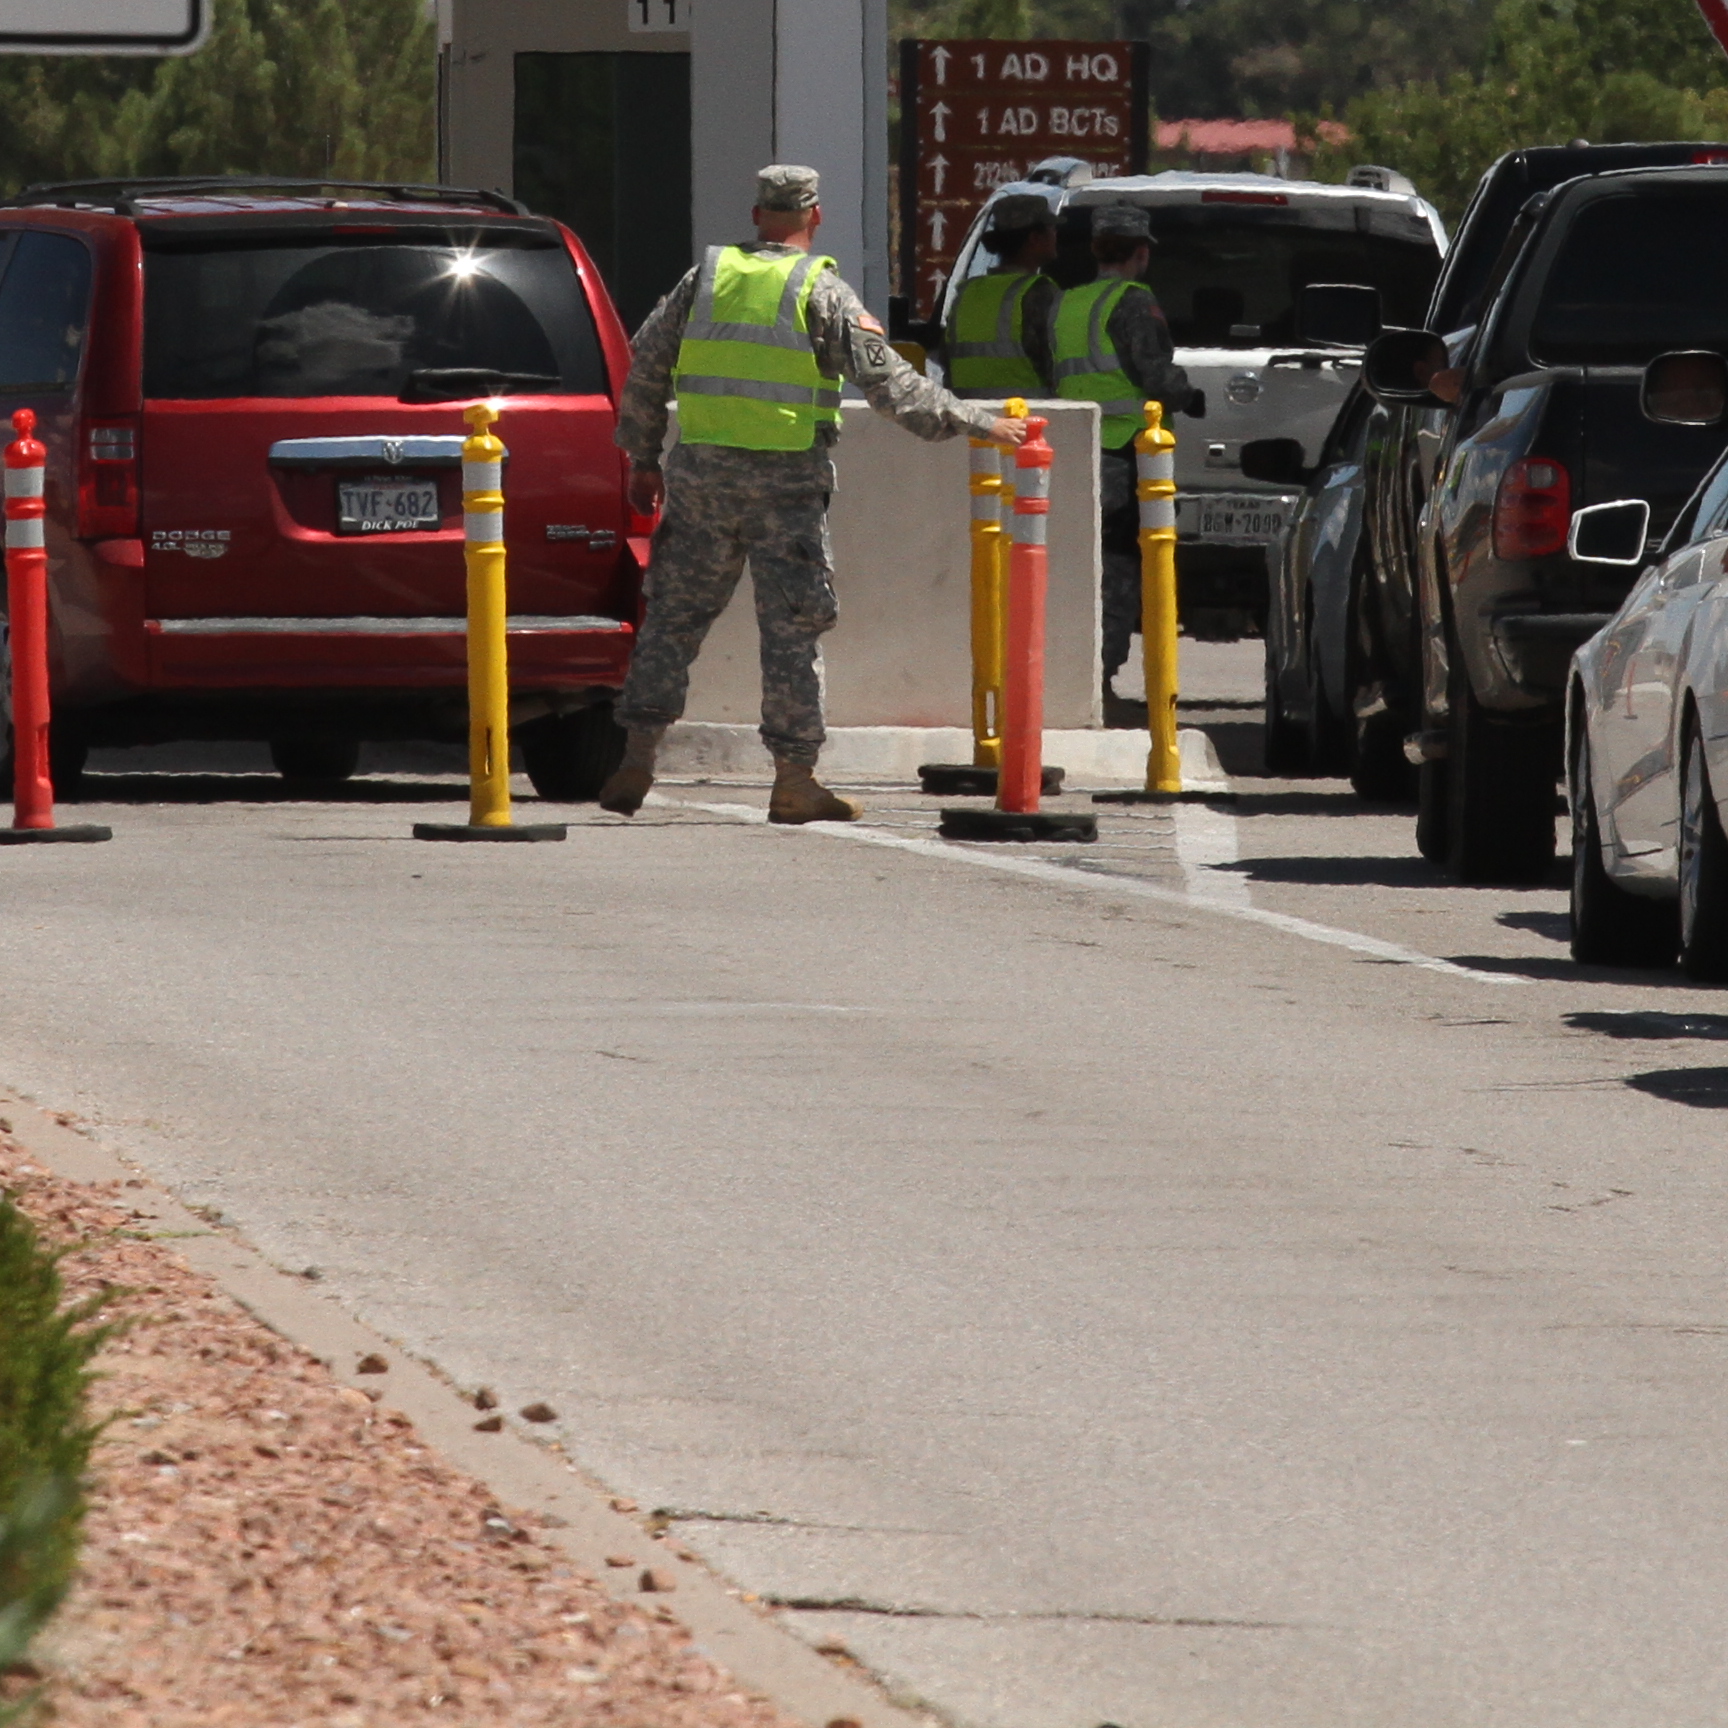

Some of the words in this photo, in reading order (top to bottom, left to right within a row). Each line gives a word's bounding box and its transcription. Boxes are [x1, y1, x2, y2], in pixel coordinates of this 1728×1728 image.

[971, 53, 986, 80] 1
[999, 52, 1050, 81] AD
[1066, 52, 1119, 82] HQ
[976, 107, 990, 135] 1
[997, 106, 1039, 136] AD
[1048, 106, 1120, 137] BCTs
[152, 529, 231, 541] DODGE
[361, 519, 393, 531] DICK
